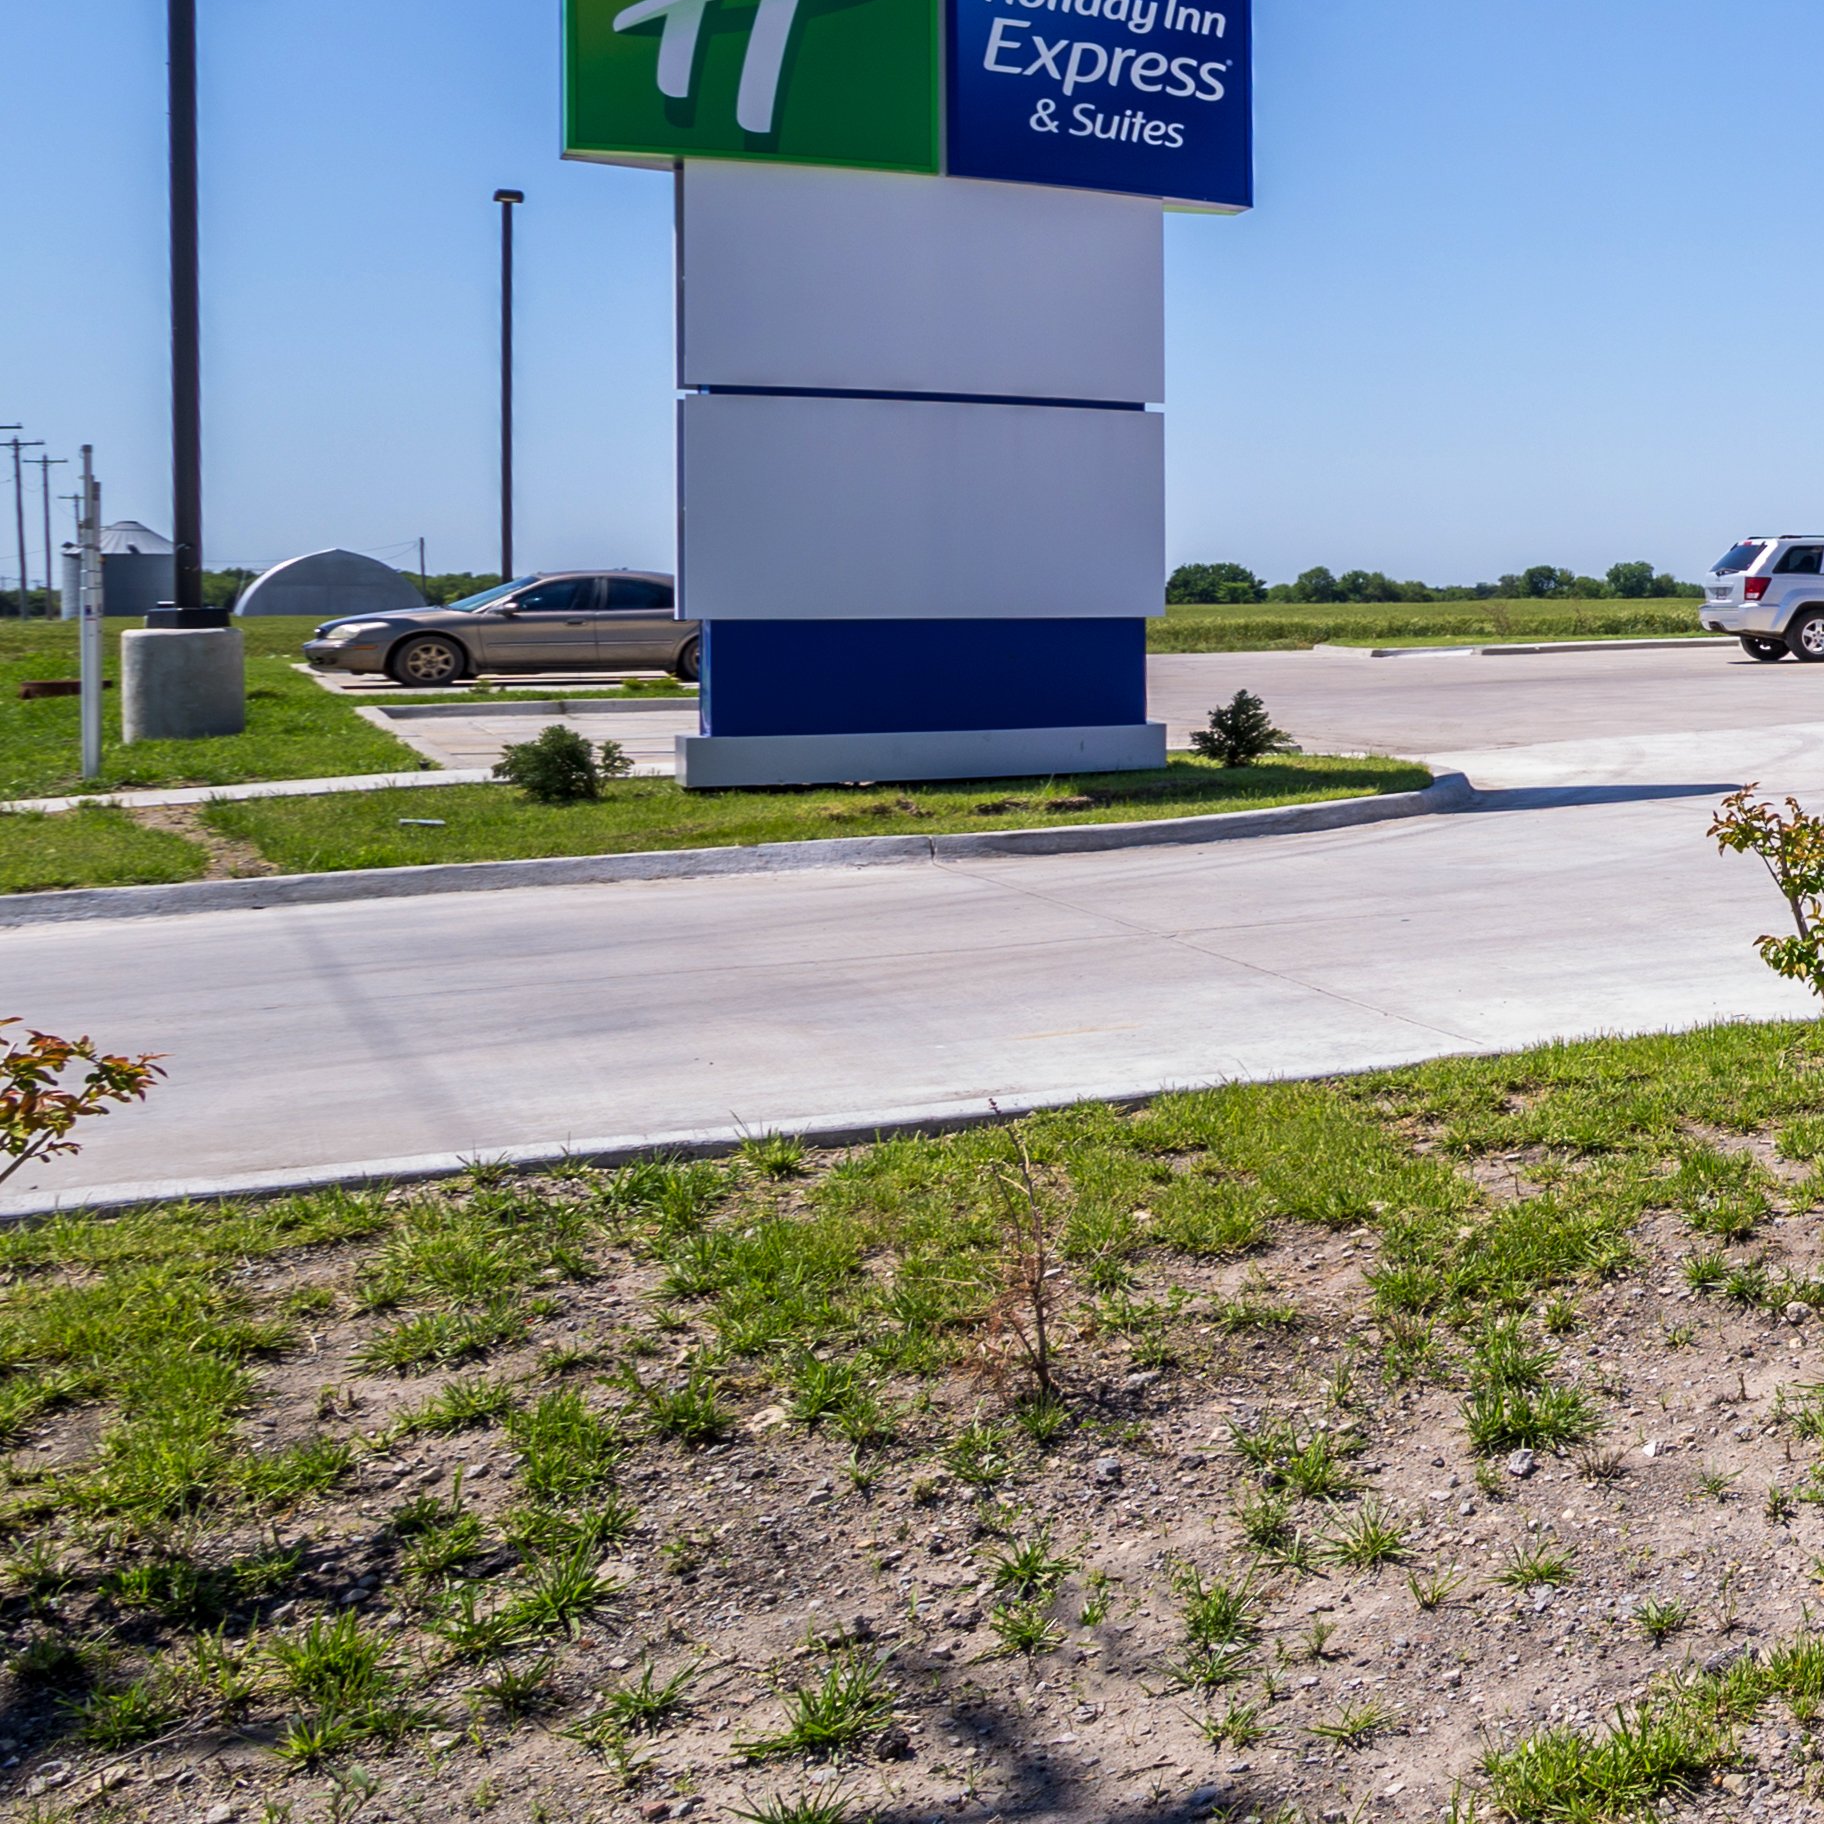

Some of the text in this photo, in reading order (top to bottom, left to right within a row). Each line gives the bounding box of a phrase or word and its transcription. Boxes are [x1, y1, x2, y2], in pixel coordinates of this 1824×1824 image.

[983, 18, 1226, 101] Express
[1030, 98, 1184, 149] & Suites
